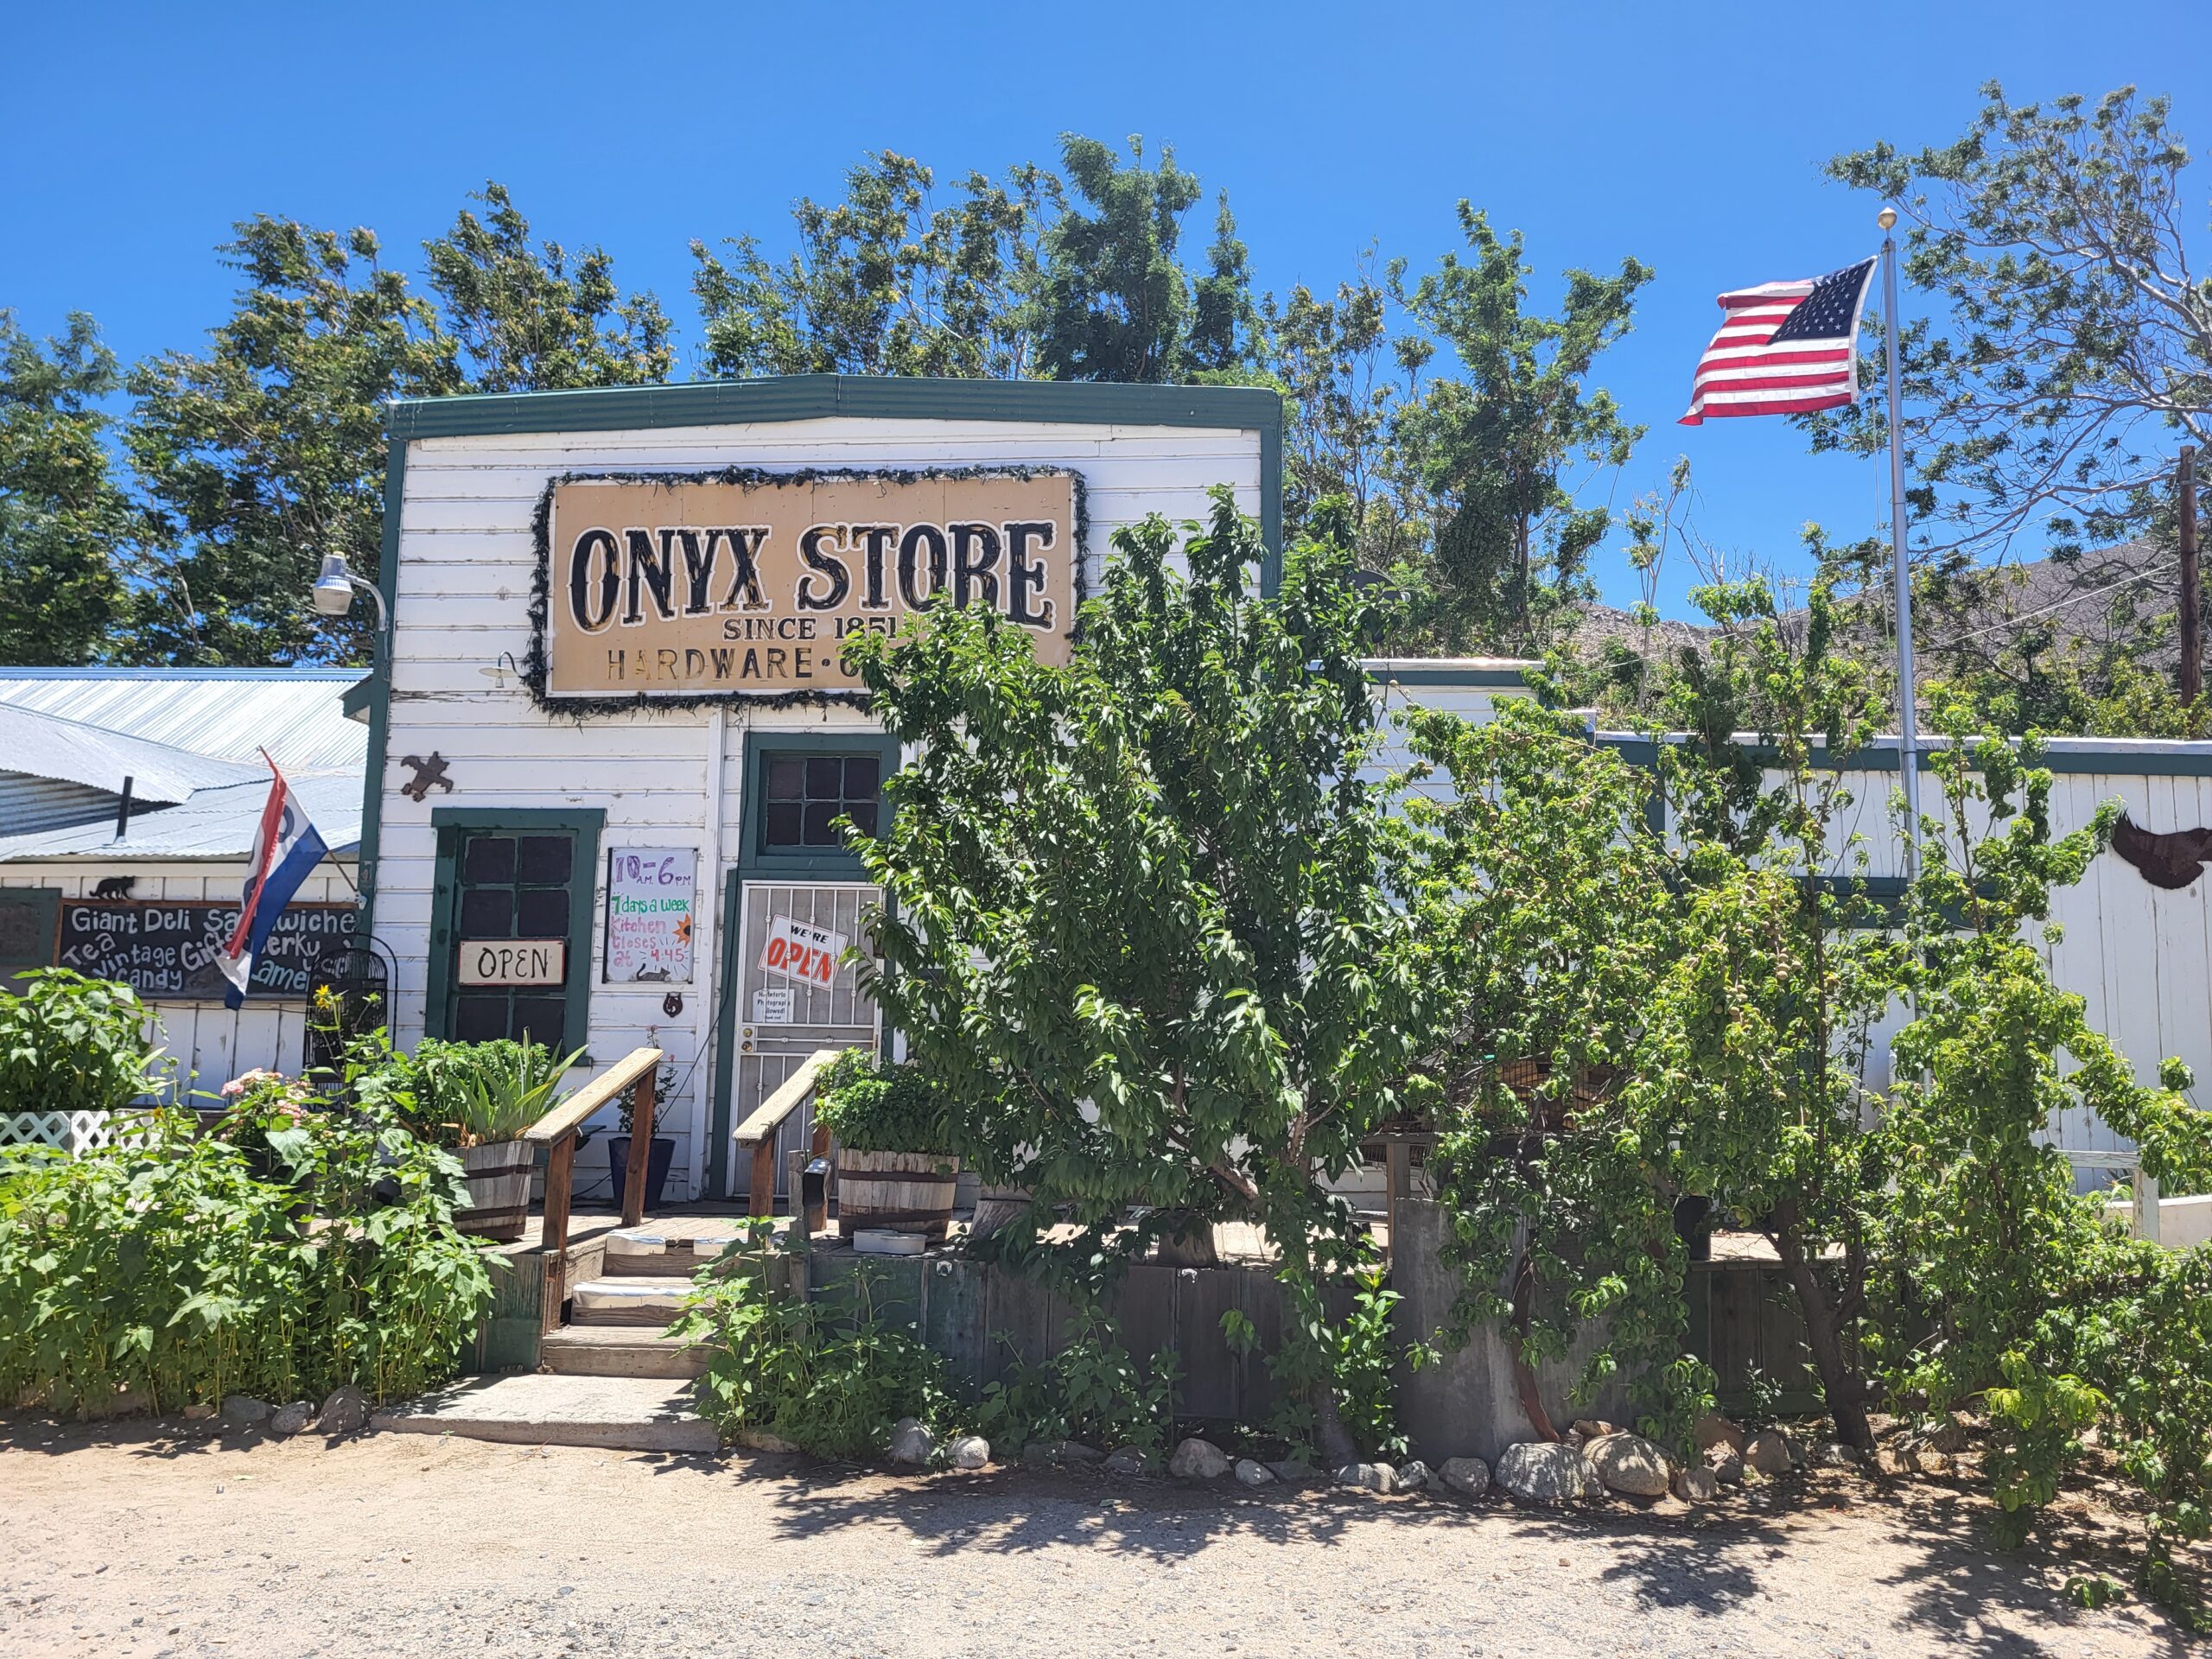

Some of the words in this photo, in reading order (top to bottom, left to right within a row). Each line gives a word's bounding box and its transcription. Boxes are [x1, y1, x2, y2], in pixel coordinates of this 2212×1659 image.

[569, 527, 772, 633] ONYX
[797, 521, 1054, 631] STORE
[723, 617, 817, 640] SINCE
[834, 616, 895, 639] 1851
[607, 648, 812, 680] HARDWARE
[611, 895, 621, 915] 7
[622, 895, 648, 914] days
[650, 899, 658, 912] a
[661, 899, 690, 912] week
[72, 907, 137, 933] Giant
[145, 909, 192, 932] Deli
[610, 916, 666, 934] Kitchen
[262, 932, 321, 962] erky
[791, 925, 829, 944] WE'RE
[62, 932, 117, 966] Tea
[478, 947, 548, 979] OPEN
[613, 950, 633, 967] at
[650, 949, 684, 962] 4:45
[766, 937, 835, 982] OPEN
